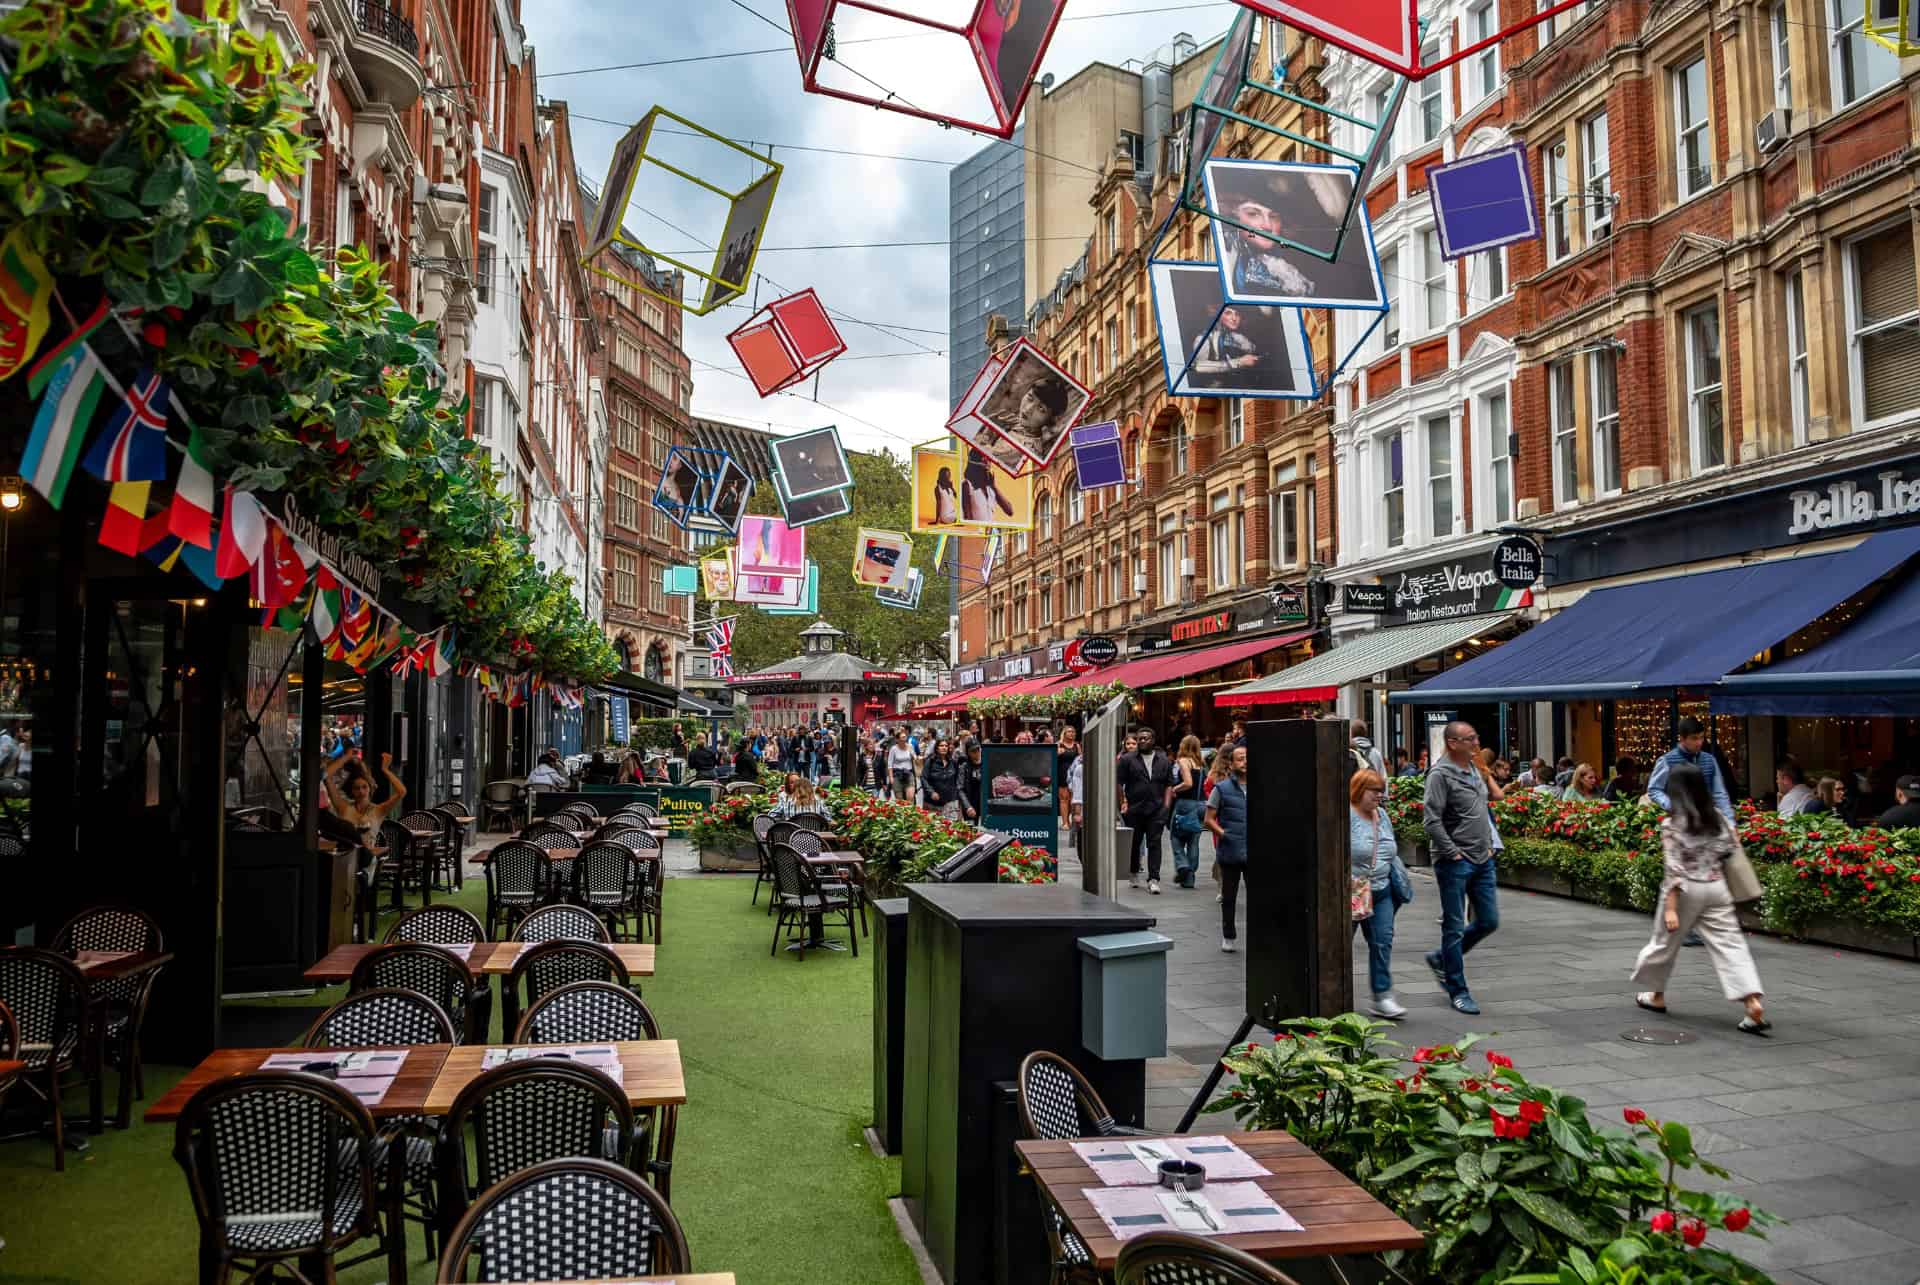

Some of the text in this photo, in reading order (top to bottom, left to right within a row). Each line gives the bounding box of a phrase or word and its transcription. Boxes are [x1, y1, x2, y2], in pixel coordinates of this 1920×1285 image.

[1788, 481, 1875, 535] Bella
[283, 492, 320, 556] Steak
[1501, 546, 1534, 563] Bella
[1443, 564, 1497, 600] Vespa
[1501, 564, 1535, 581] Italia
[1348, 587, 1385, 604] Vespa
[1406, 600, 1477, 623] Italian Restaurant
[1171, 612, 1230, 641] LITTLE ITALY
[1012, 828, 1049, 839] Stones
